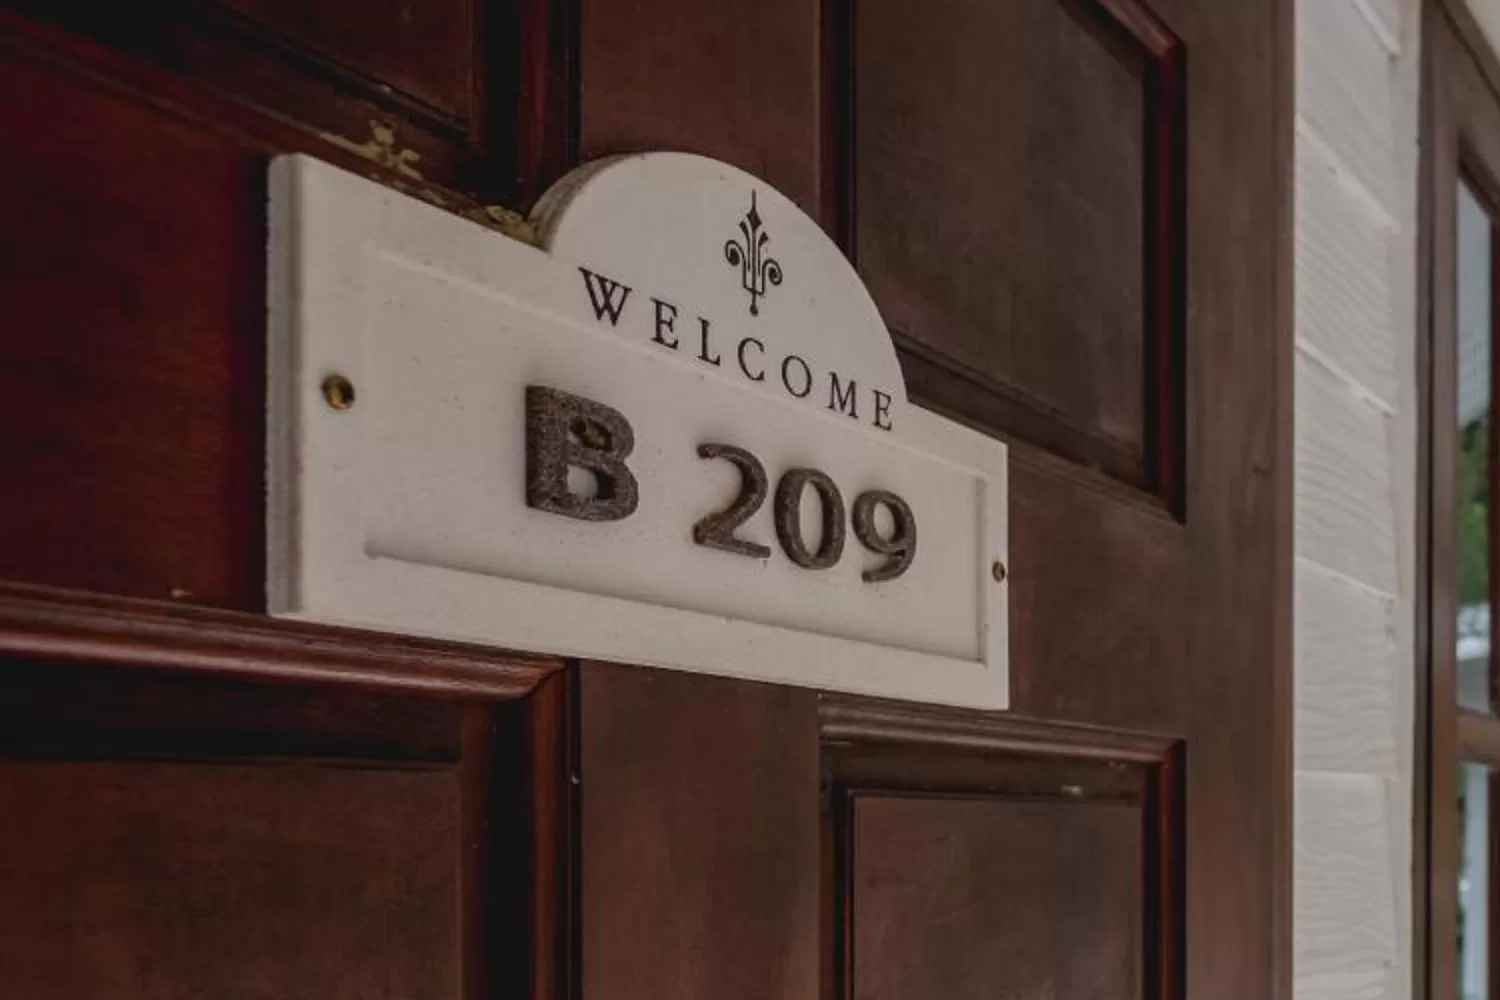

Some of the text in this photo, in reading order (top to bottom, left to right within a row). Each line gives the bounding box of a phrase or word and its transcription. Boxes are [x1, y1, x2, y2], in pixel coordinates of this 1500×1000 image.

[578, 266, 893, 431] WELCOME
[525, 384, 917, 583] B 209
